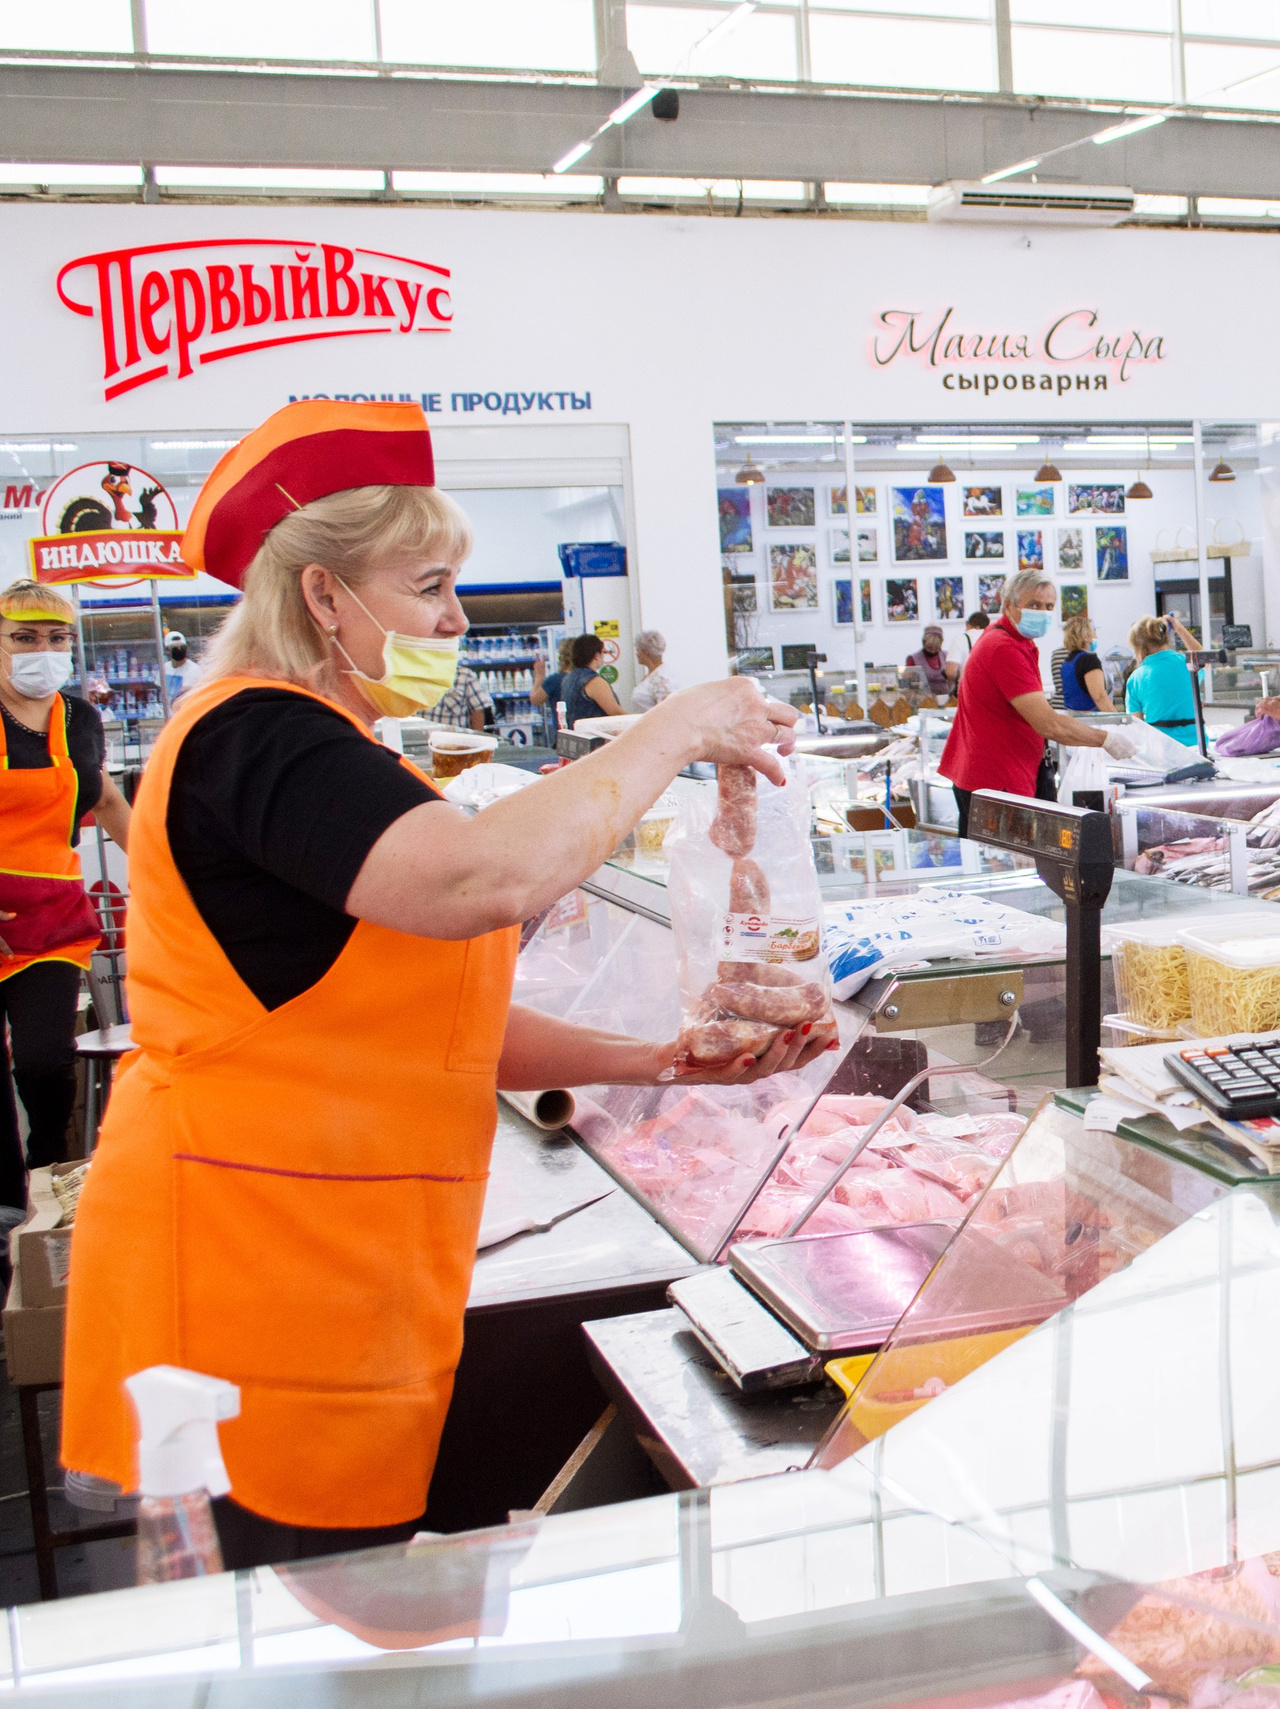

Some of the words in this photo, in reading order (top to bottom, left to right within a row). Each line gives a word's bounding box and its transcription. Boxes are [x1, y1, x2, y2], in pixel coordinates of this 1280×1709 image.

[873, 307, 1034, 366] Магия
[1043, 308, 1167, 382] Сыра
[942, 373, 1109, 396] сыроварня
[450, 391, 592, 415] ПРОДУКТЫ
[40, 540, 184, 570] ИНДЮШКА
